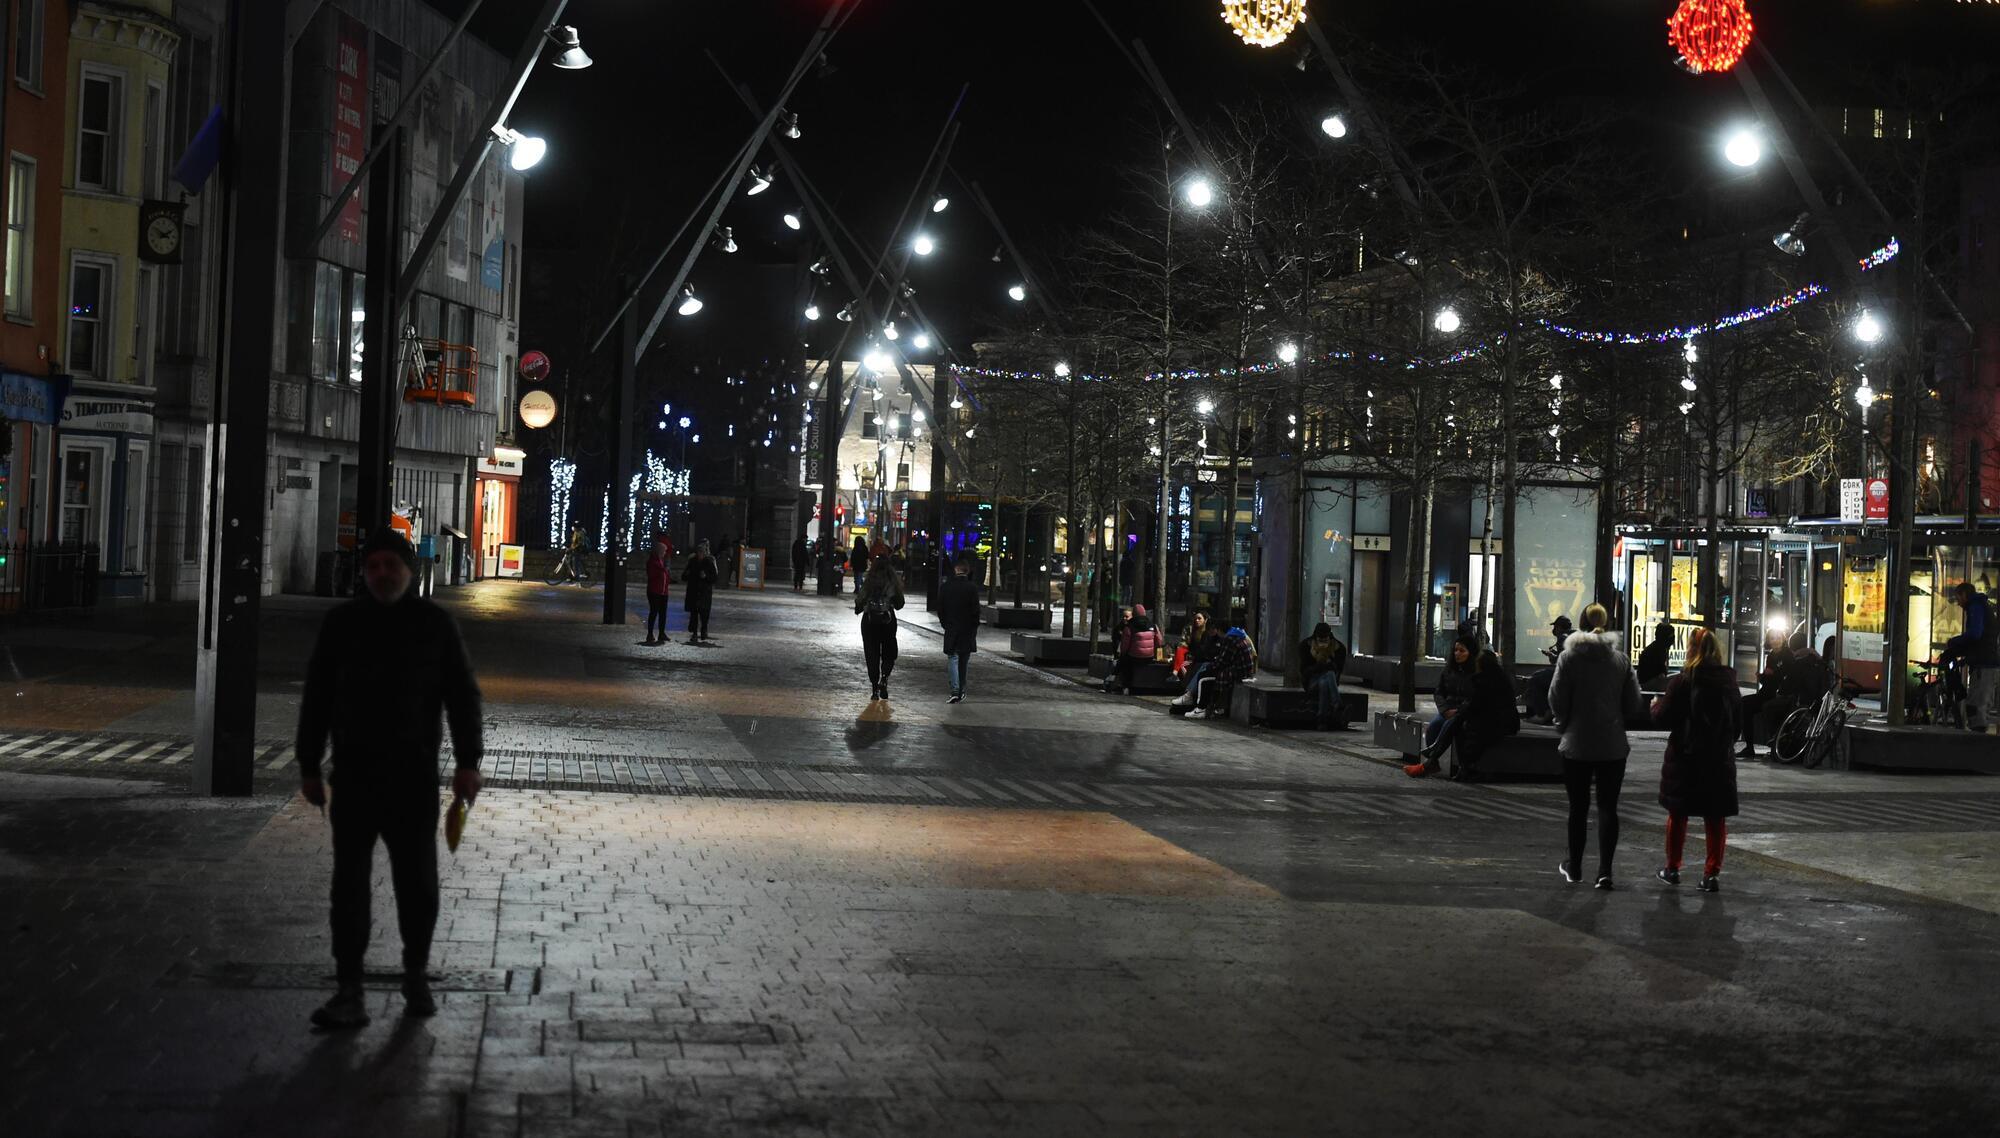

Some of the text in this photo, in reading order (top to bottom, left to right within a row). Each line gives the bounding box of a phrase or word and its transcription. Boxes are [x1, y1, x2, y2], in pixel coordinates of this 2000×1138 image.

[340, 42, 359, 80] CORK
[75, 402, 126, 417] TIMOTHY
[1842, 481, 1861, 489] CORK
